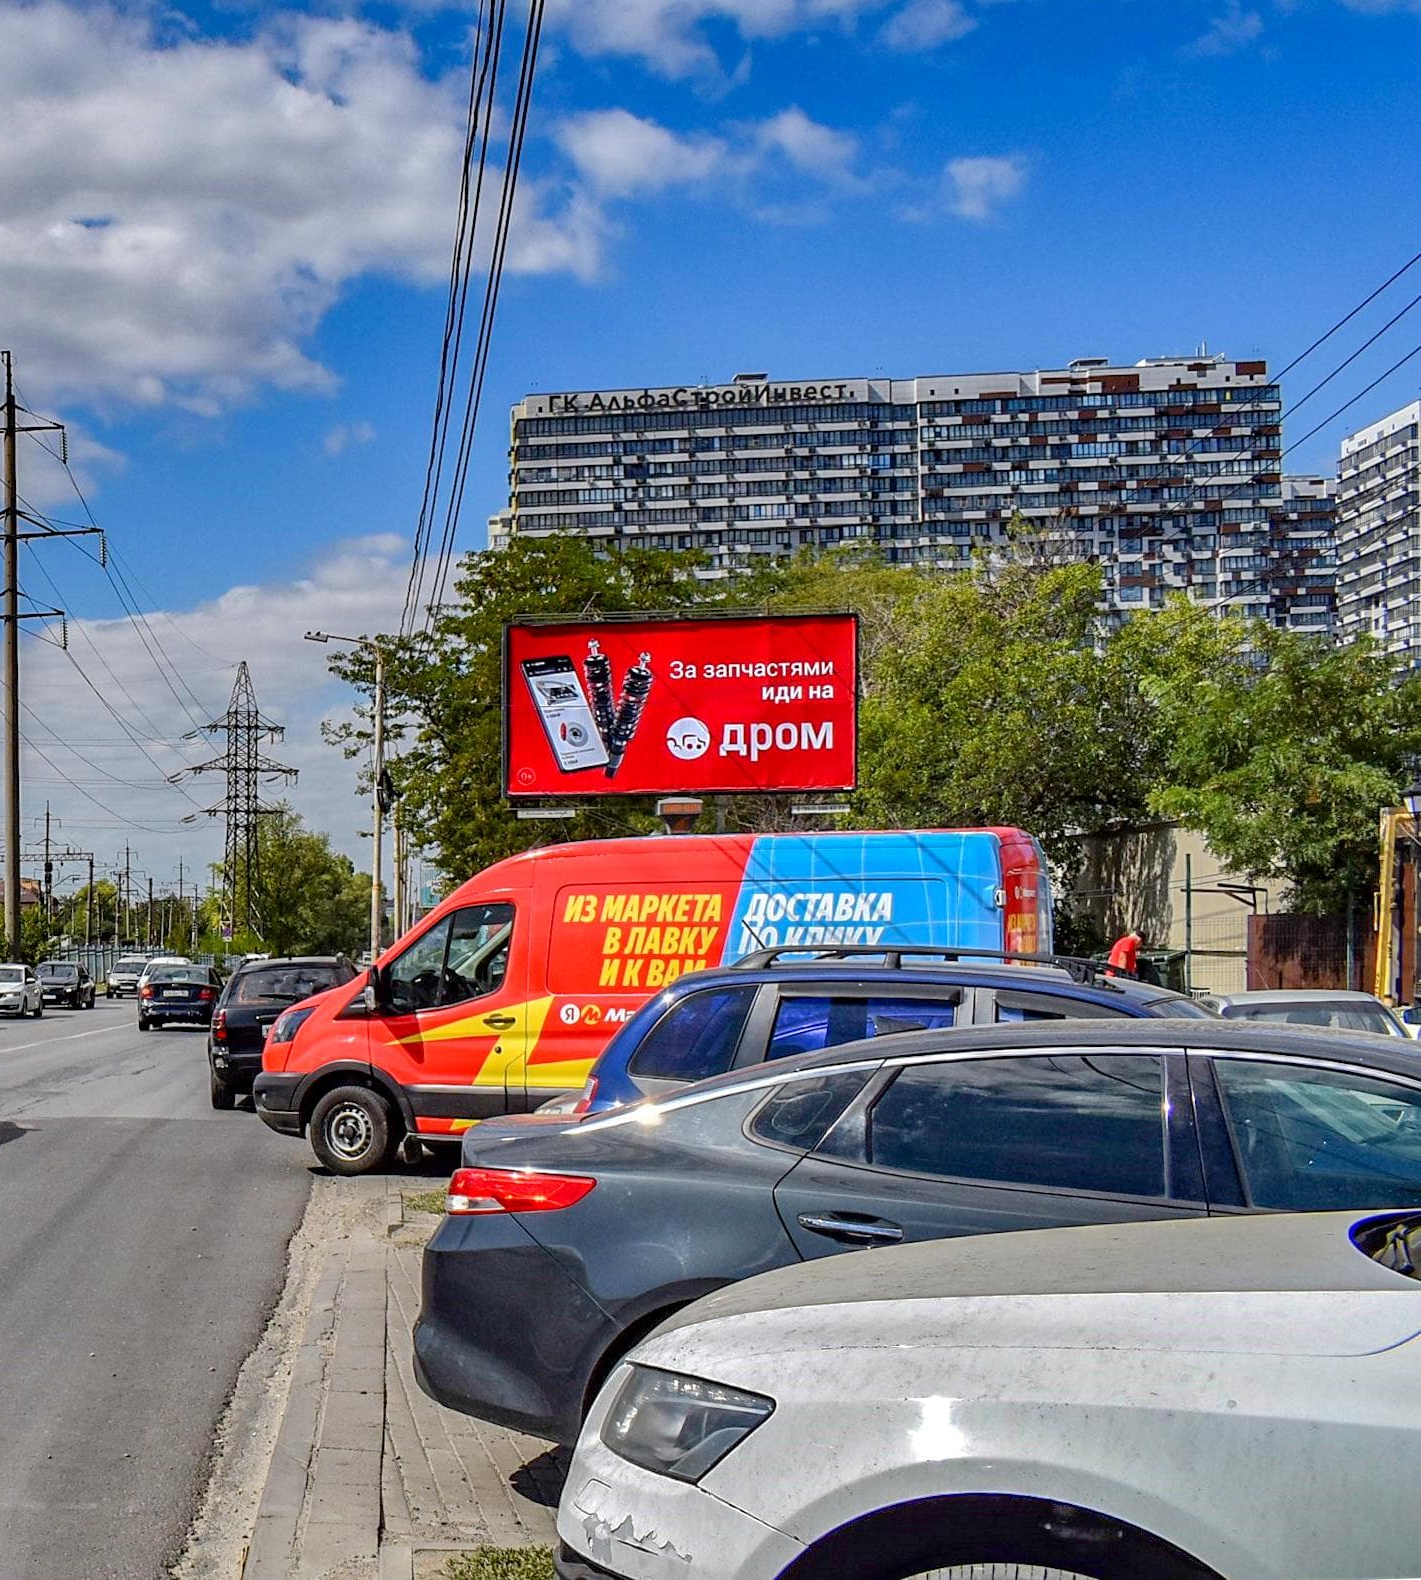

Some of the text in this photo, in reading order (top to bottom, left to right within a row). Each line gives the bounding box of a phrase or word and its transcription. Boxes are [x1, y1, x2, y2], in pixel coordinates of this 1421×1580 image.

[548, 394, 579, 413] ГК
[669, 660, 834, 679] За запчастями
[761, 684, 834, 704] иди на
[719, 721, 834, 762] дром
[563, 894, 722, 923] ИЗ МАРКЕТА
[743, 893, 893, 927] ДОСТАВКА
[601, 926, 719, 955] В ЛАВКУ
[738, 926, 779, 955] ПО
[598, 958, 621, 987] И
[622, 958, 644, 987] К
